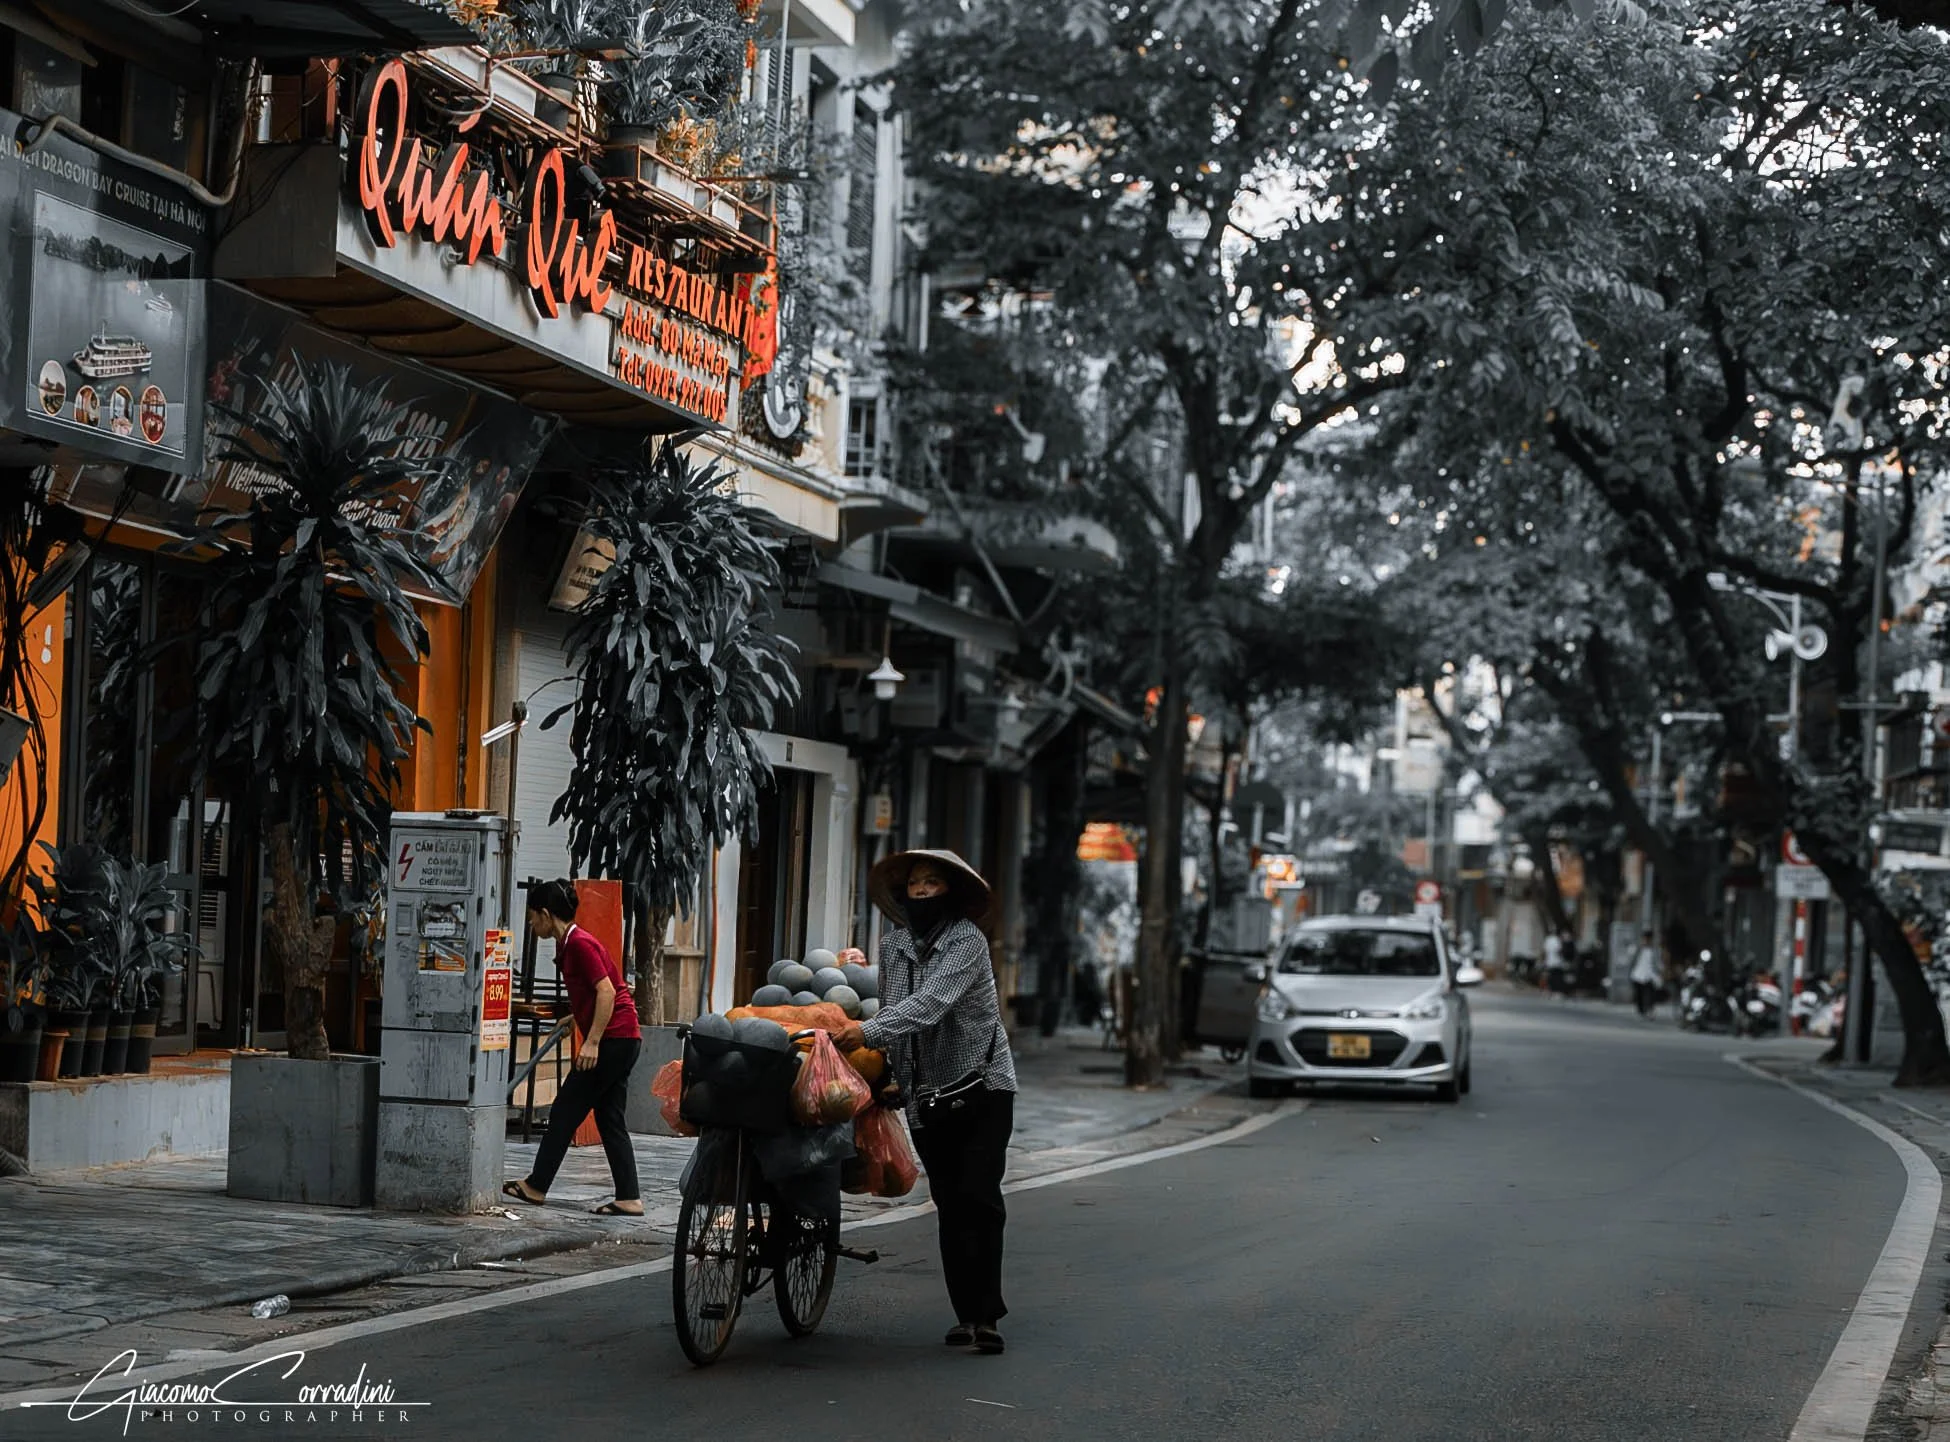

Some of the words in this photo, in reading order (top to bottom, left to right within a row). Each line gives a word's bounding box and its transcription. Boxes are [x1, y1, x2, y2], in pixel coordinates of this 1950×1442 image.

[42, 150, 91, 187] DRAGON
[92, 171, 114, 196] BAY
[115, 182, 151, 210] CRUISE
[170, 200, 185, 225] HÀ
[360, 58, 505, 266] Quán
[527, 148, 617, 319] Quê
[627, 245, 755, 349] RESTAURANT
[661, 318, 679, 355] 80
[645, 359, 678, 402] 0983
[703, 386, 727, 423] 005
